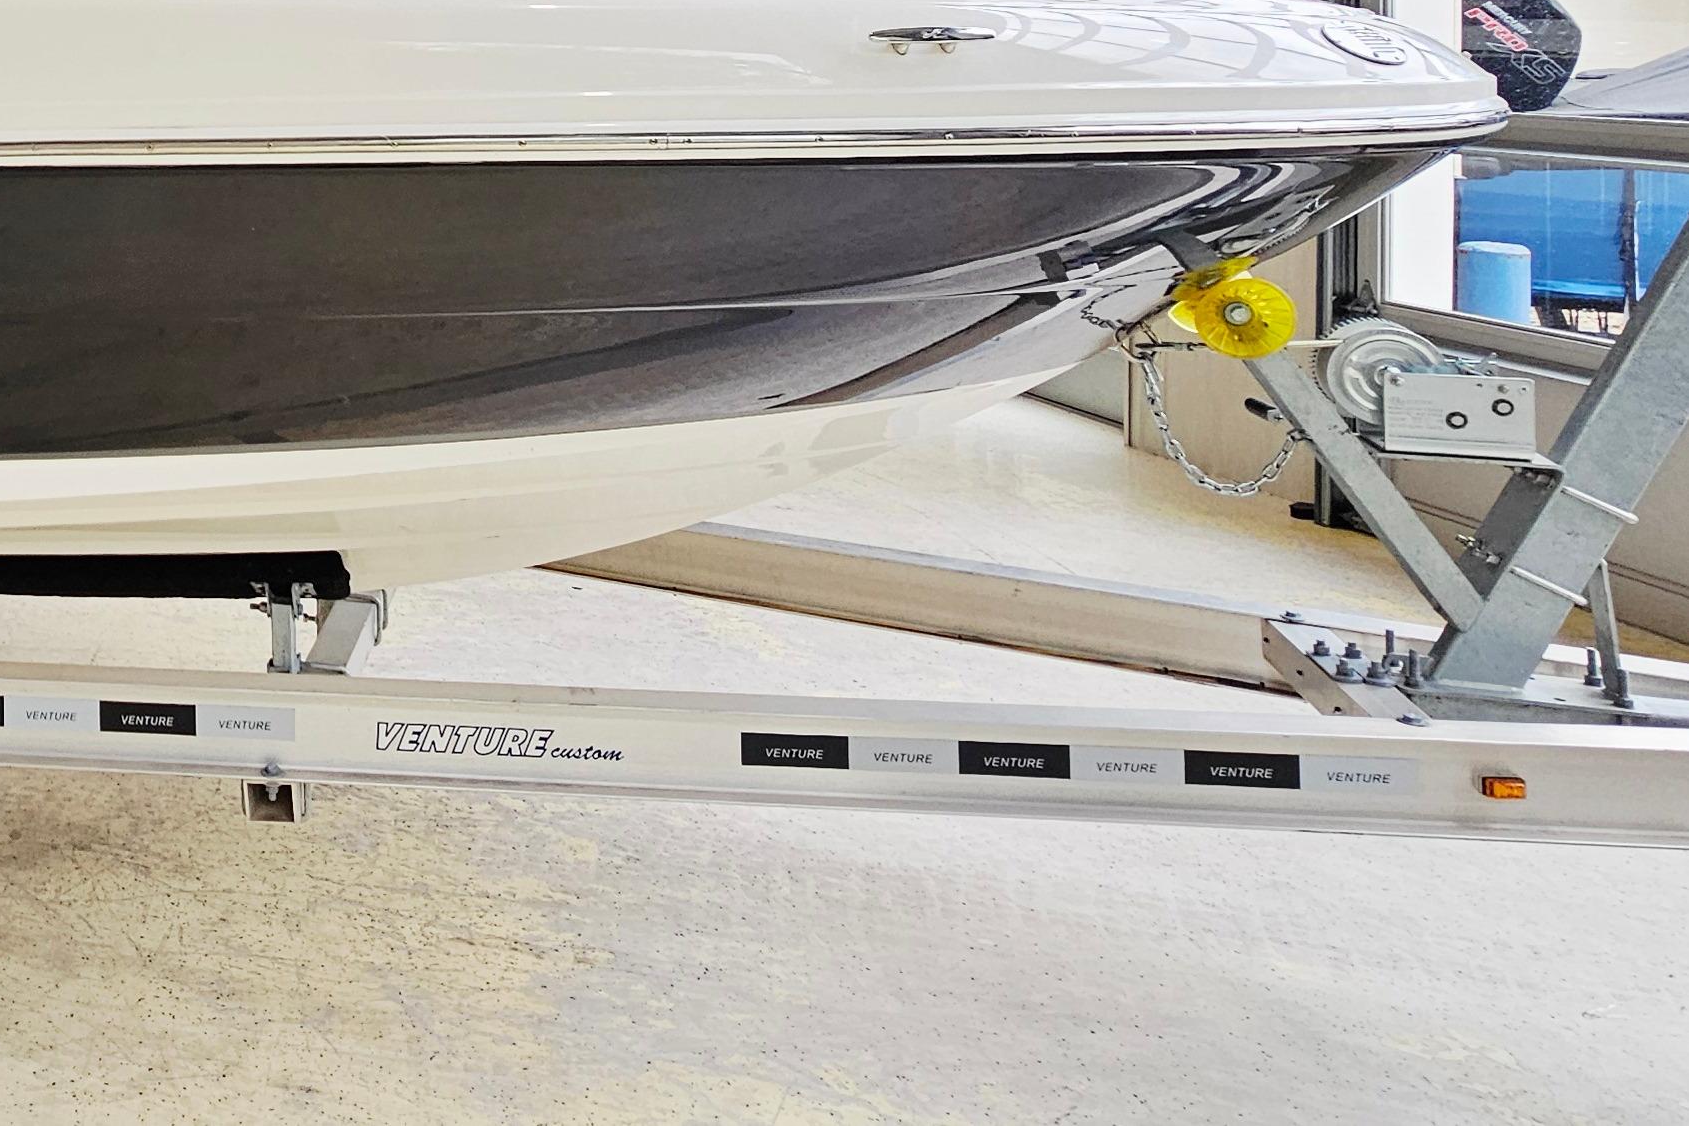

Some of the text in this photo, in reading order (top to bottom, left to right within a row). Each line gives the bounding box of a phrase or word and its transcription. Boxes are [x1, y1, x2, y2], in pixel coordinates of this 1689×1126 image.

[1463, 7, 1529, 52] PRO
[25, 709, 77, 722] VENTURE
[120, 713, 175, 727] VENTURE
[218, 718, 272, 731] VENTURE
[375, 721, 625, 762] VENTURE custom
[764, 746, 824, 760] VENTURE
[873, 752, 933, 764] VENTURE
[983, 756, 1045, 770] VENTURE
[1096, 761, 1158, 774] VENTURE
[1210, 765, 1274, 780] VENTURE
[1326, 770, 1391, 785] VENTURE
